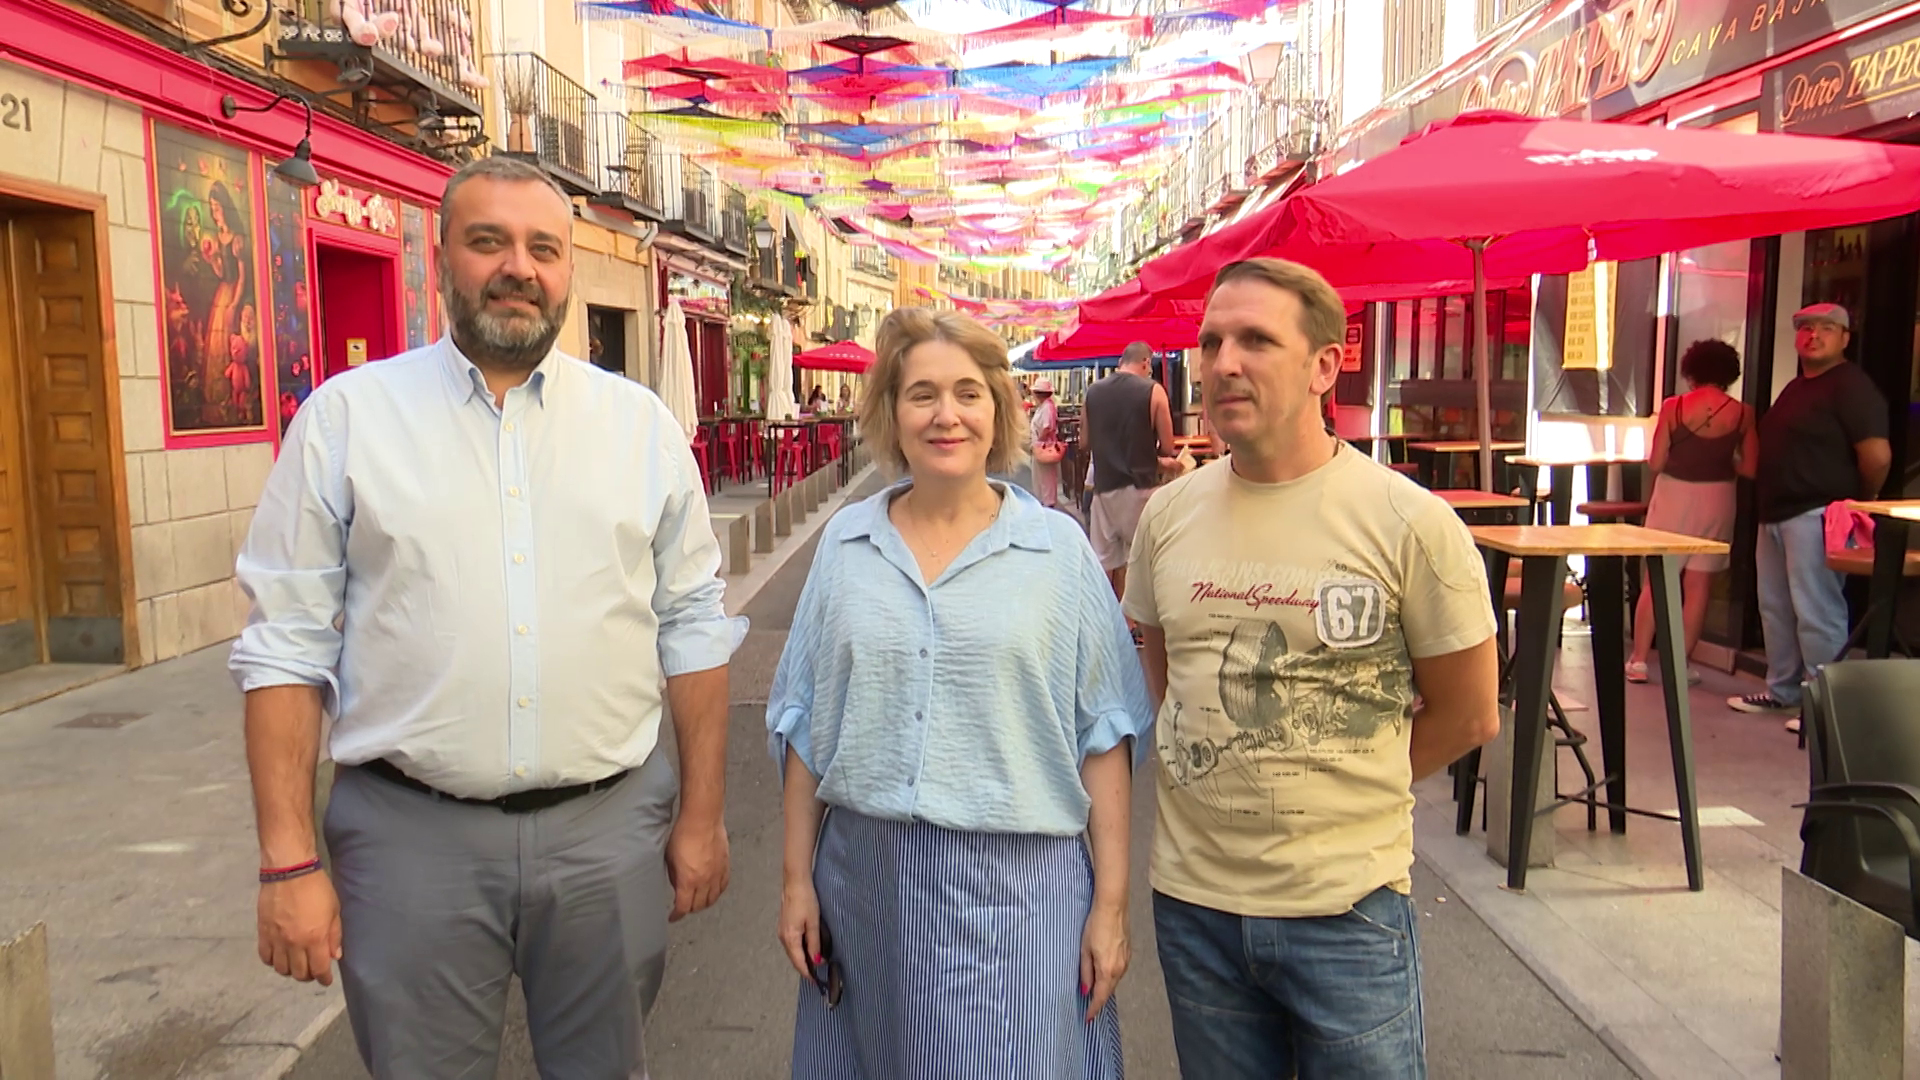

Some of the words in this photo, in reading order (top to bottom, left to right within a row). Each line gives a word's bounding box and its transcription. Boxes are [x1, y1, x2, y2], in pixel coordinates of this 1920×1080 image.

[1672, 18, 1738, 66] CAVA
[1750, 0, 1825, 32] BAJ
[0, 93, 32, 132] 21
[1779, 61, 1845, 122] Puro
[1190, 581, 1256, 604] National
[1245, 583, 1320, 616] Speedway
[1326, 586, 1375, 640] 67
